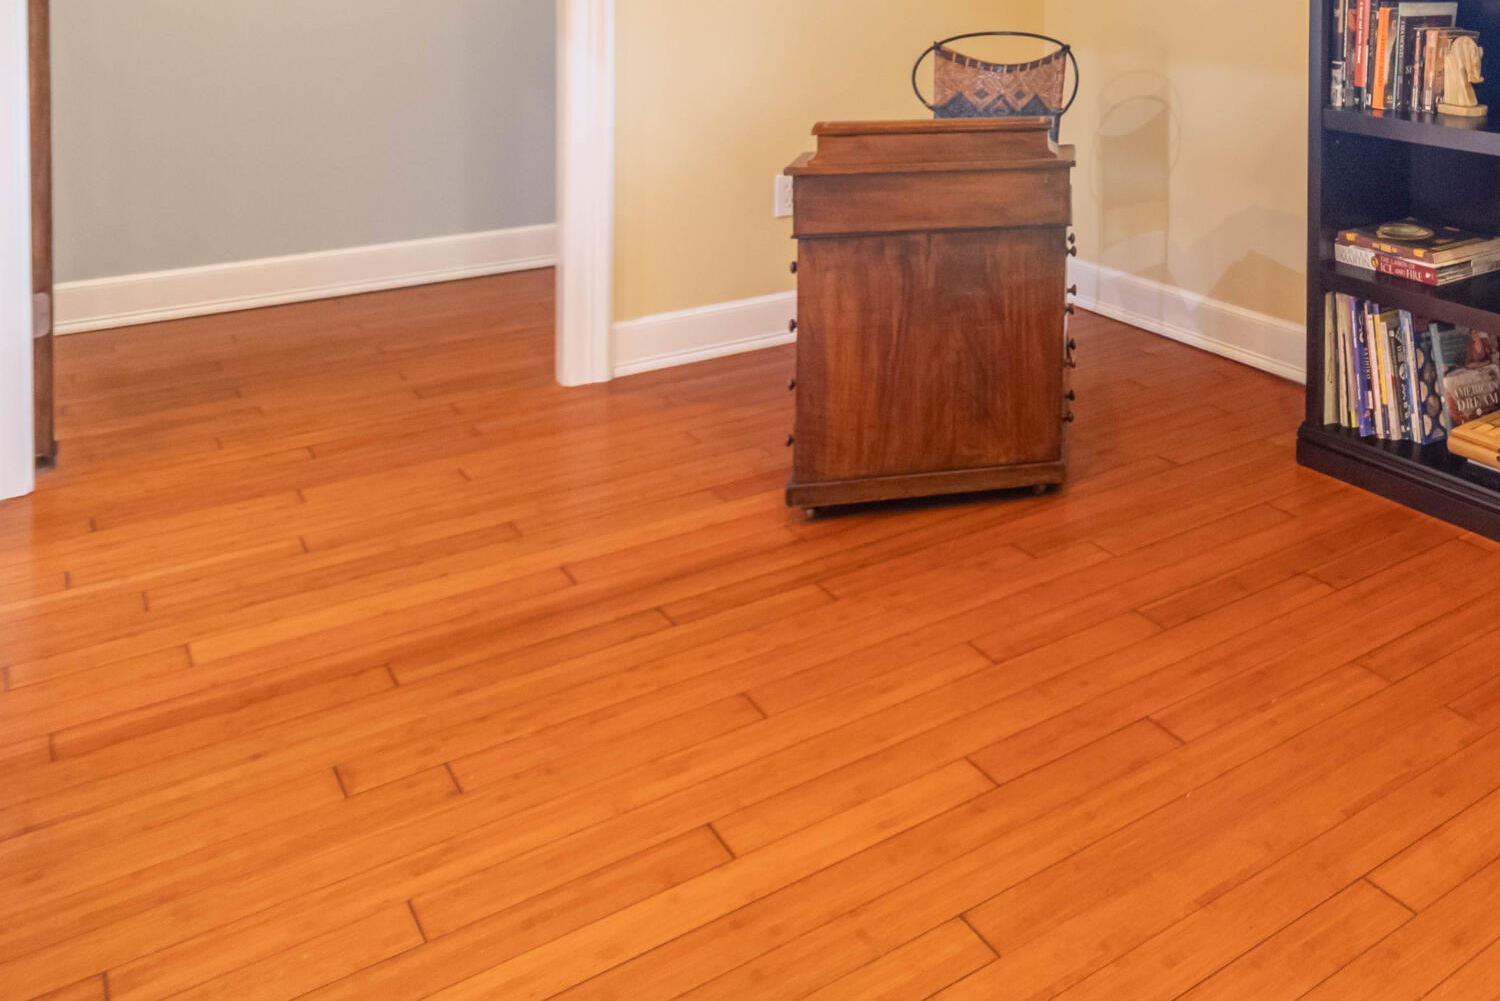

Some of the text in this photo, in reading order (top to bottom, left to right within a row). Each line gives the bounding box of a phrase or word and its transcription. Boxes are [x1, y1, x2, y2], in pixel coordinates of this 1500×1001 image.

[1381, 263, 1394, 275] ICE
[1406, 269, 1423, 282] FIRE
[1457, 392, 1499, 411] DREAM
